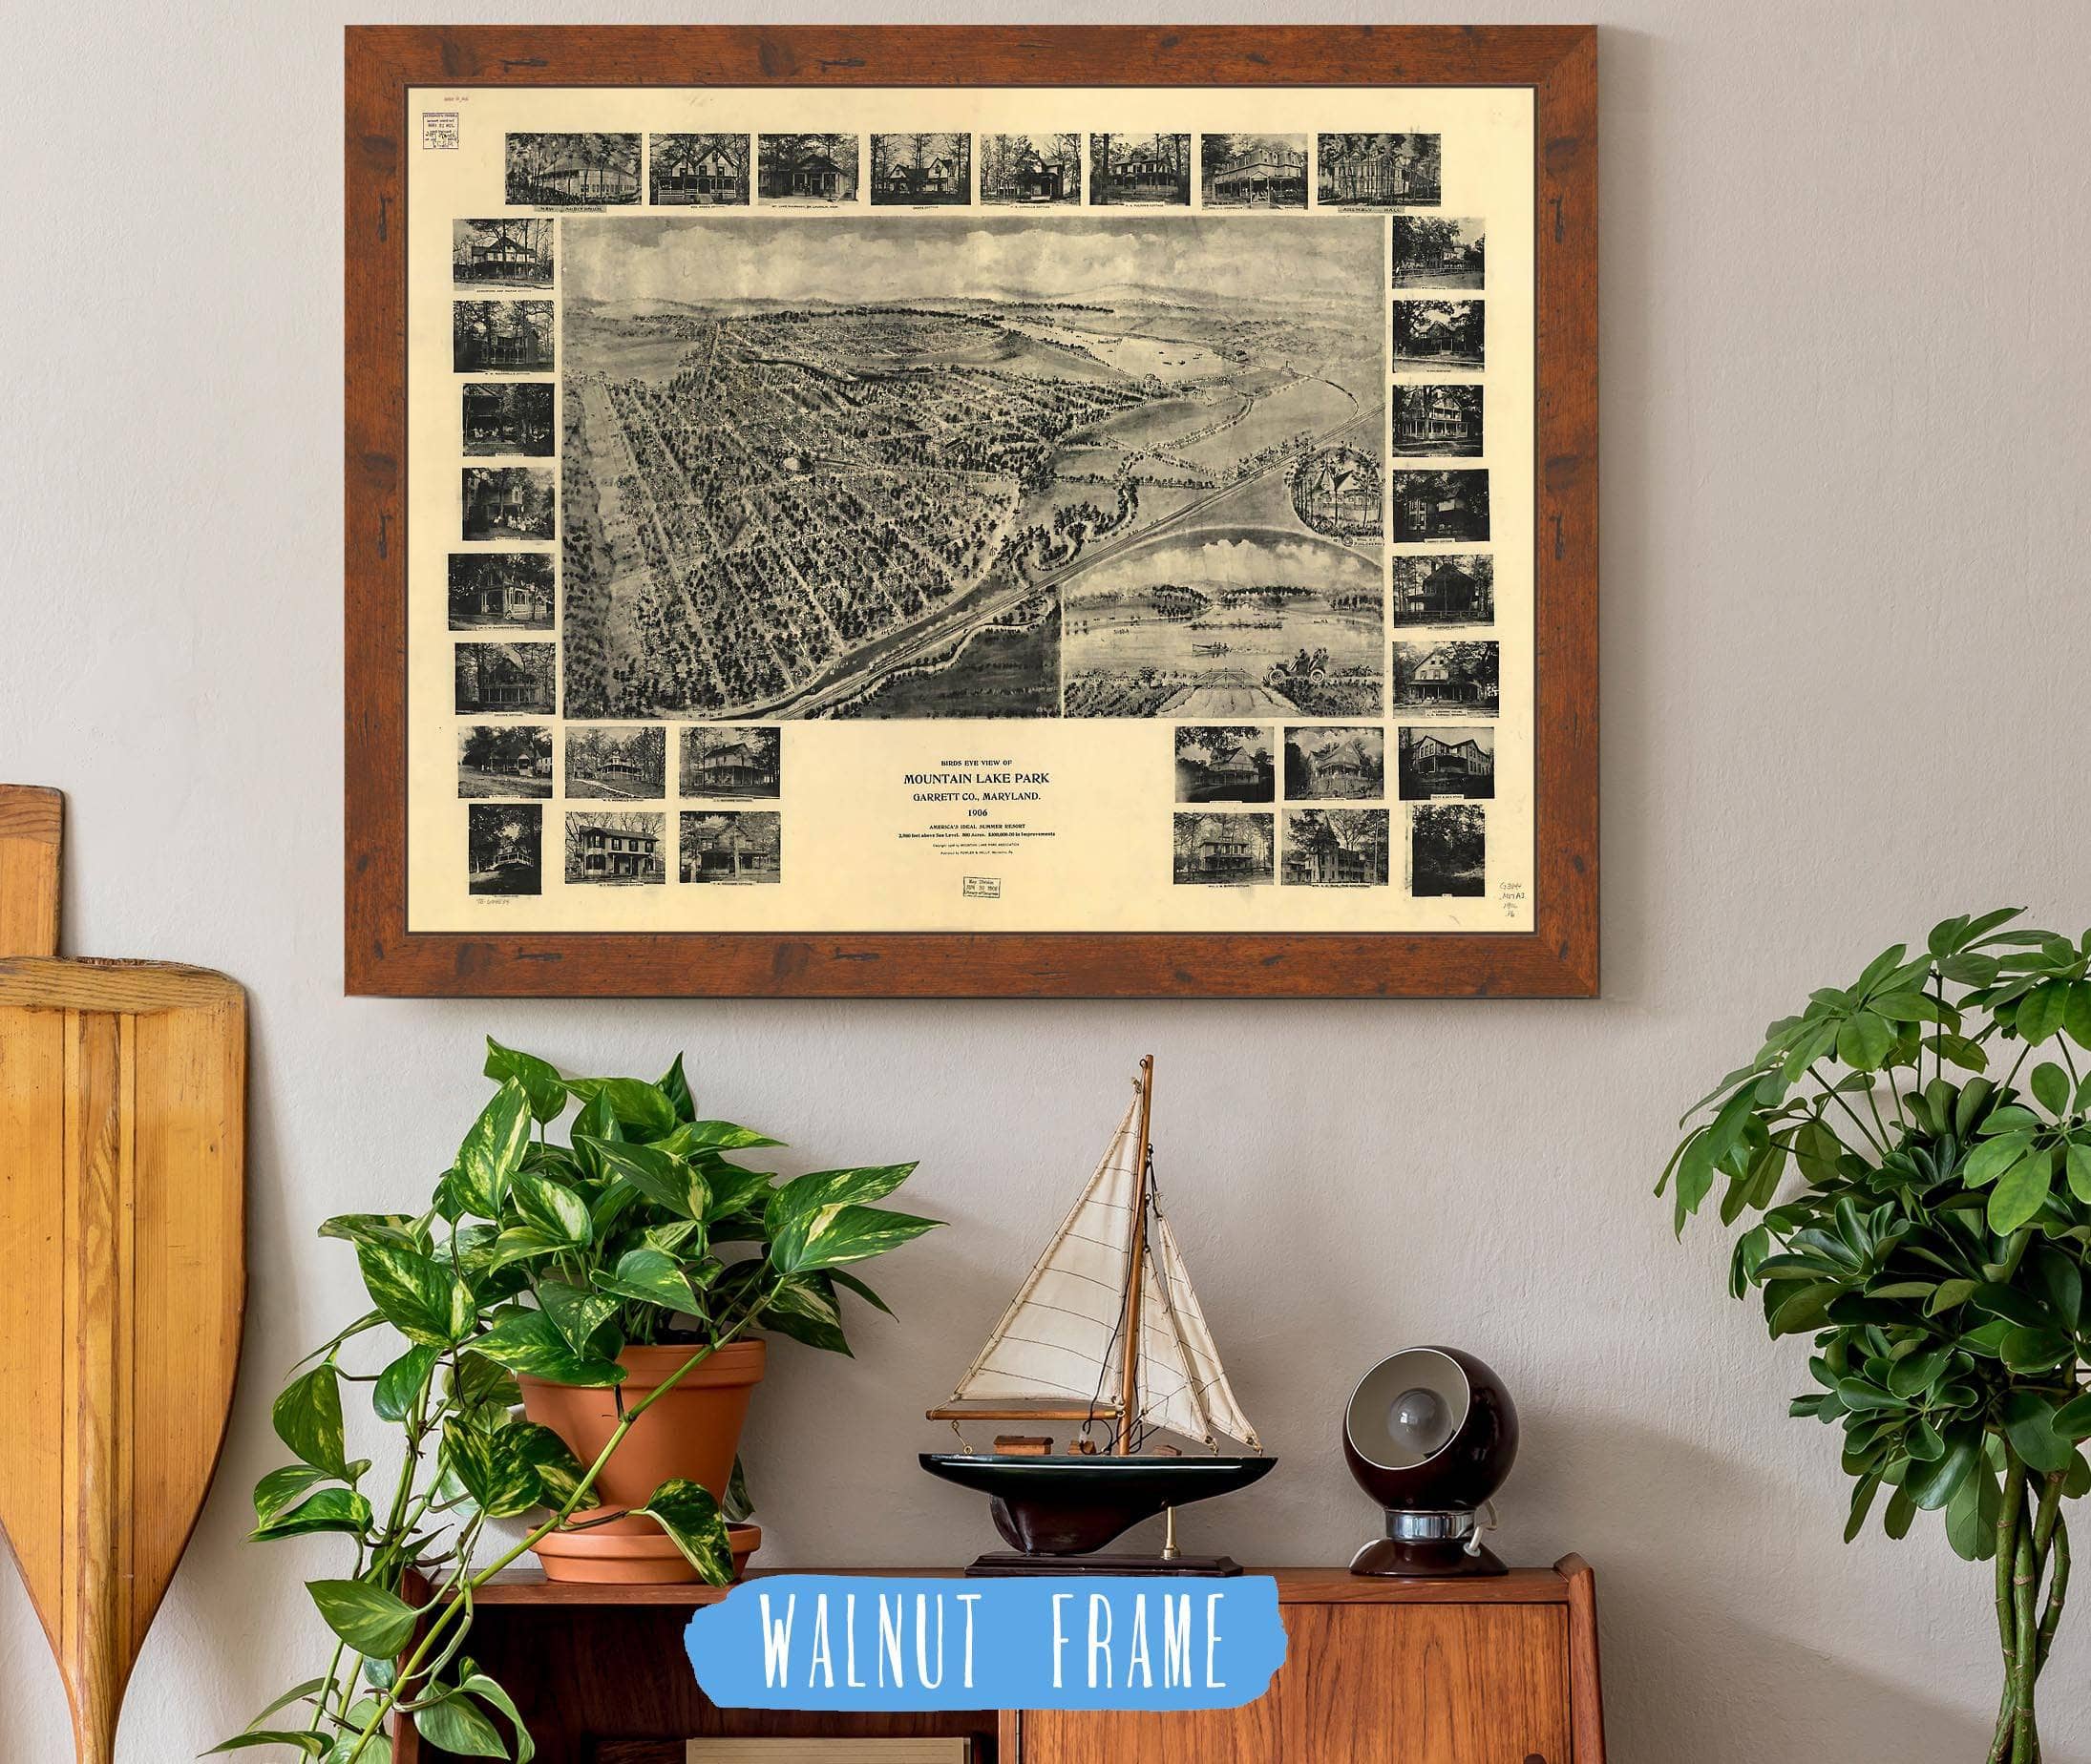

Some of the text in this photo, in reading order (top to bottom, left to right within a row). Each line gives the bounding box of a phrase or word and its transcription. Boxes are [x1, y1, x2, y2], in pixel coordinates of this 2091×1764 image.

[903, 773, 1050, 785] MOUNTAIN LAKE PARK
[913, 792, 1042, 802] GARRETT CO., MARYLAND.
